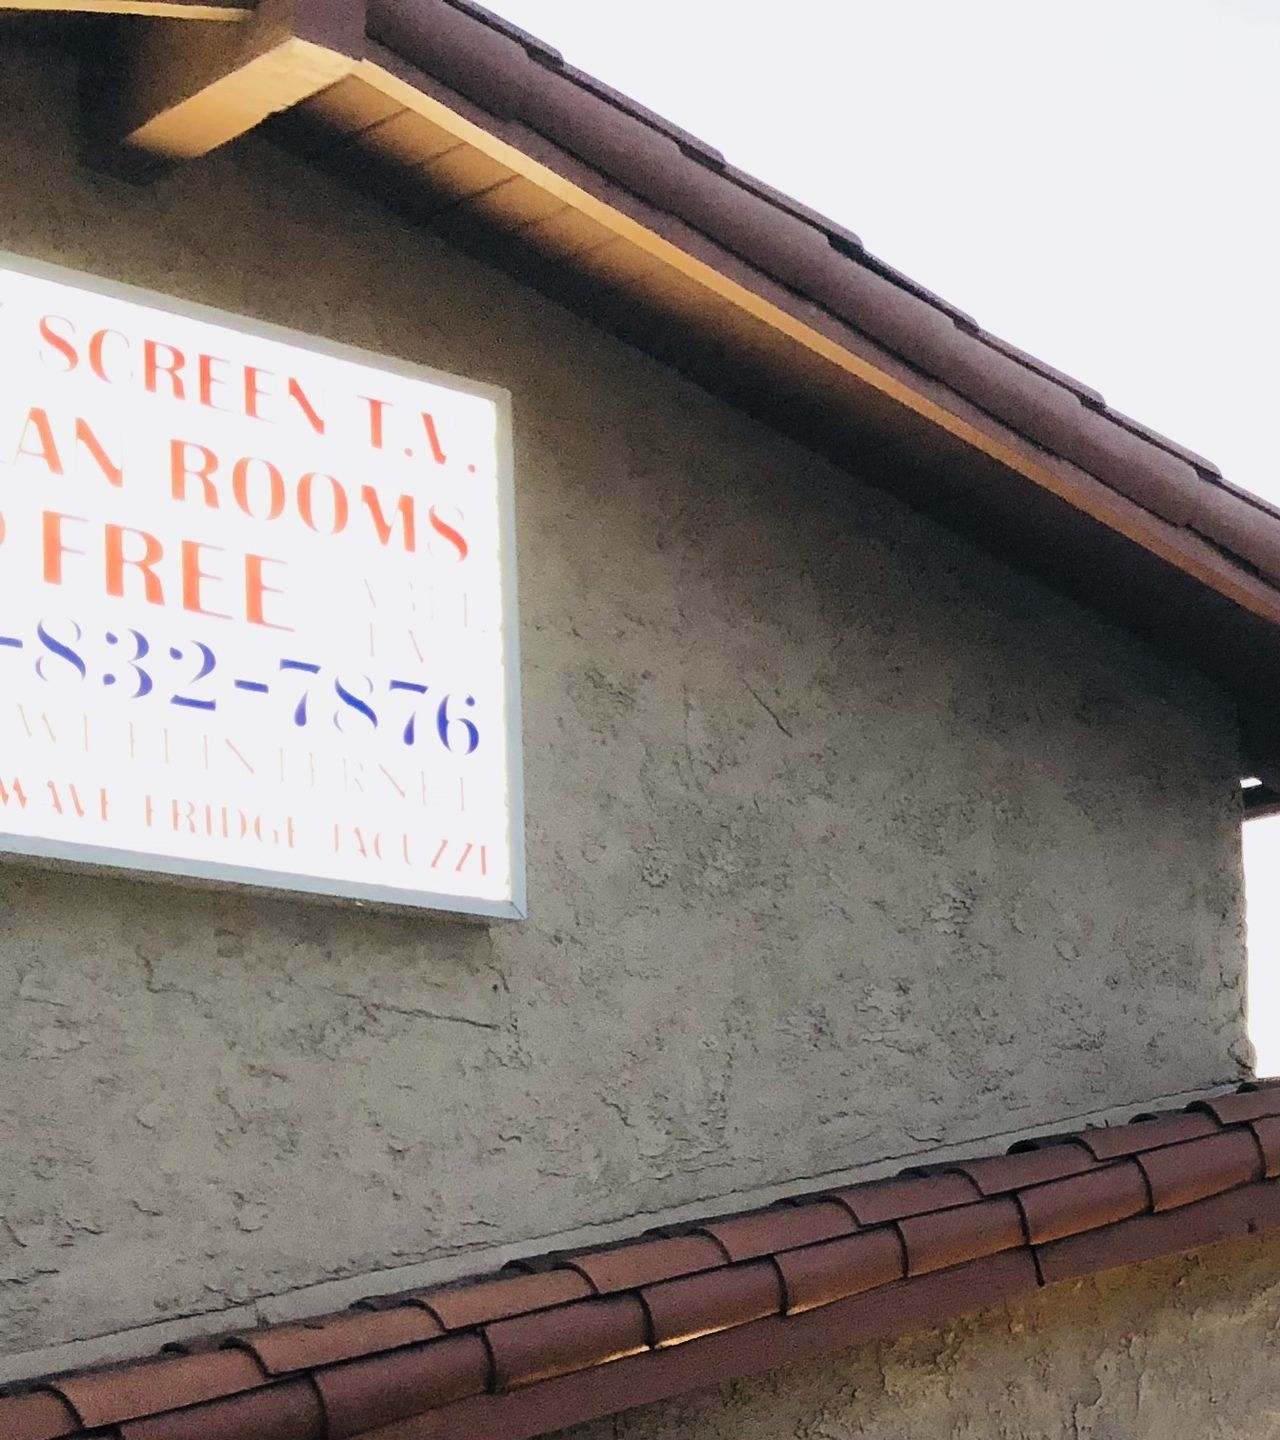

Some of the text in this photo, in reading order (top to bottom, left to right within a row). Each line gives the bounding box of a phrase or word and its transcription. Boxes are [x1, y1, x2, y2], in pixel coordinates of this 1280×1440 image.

[37, 313, 477, 474] SCREEN T.V.
[169, 437, 469, 563] ROOMS
[42, 509, 296, 634] FREE
